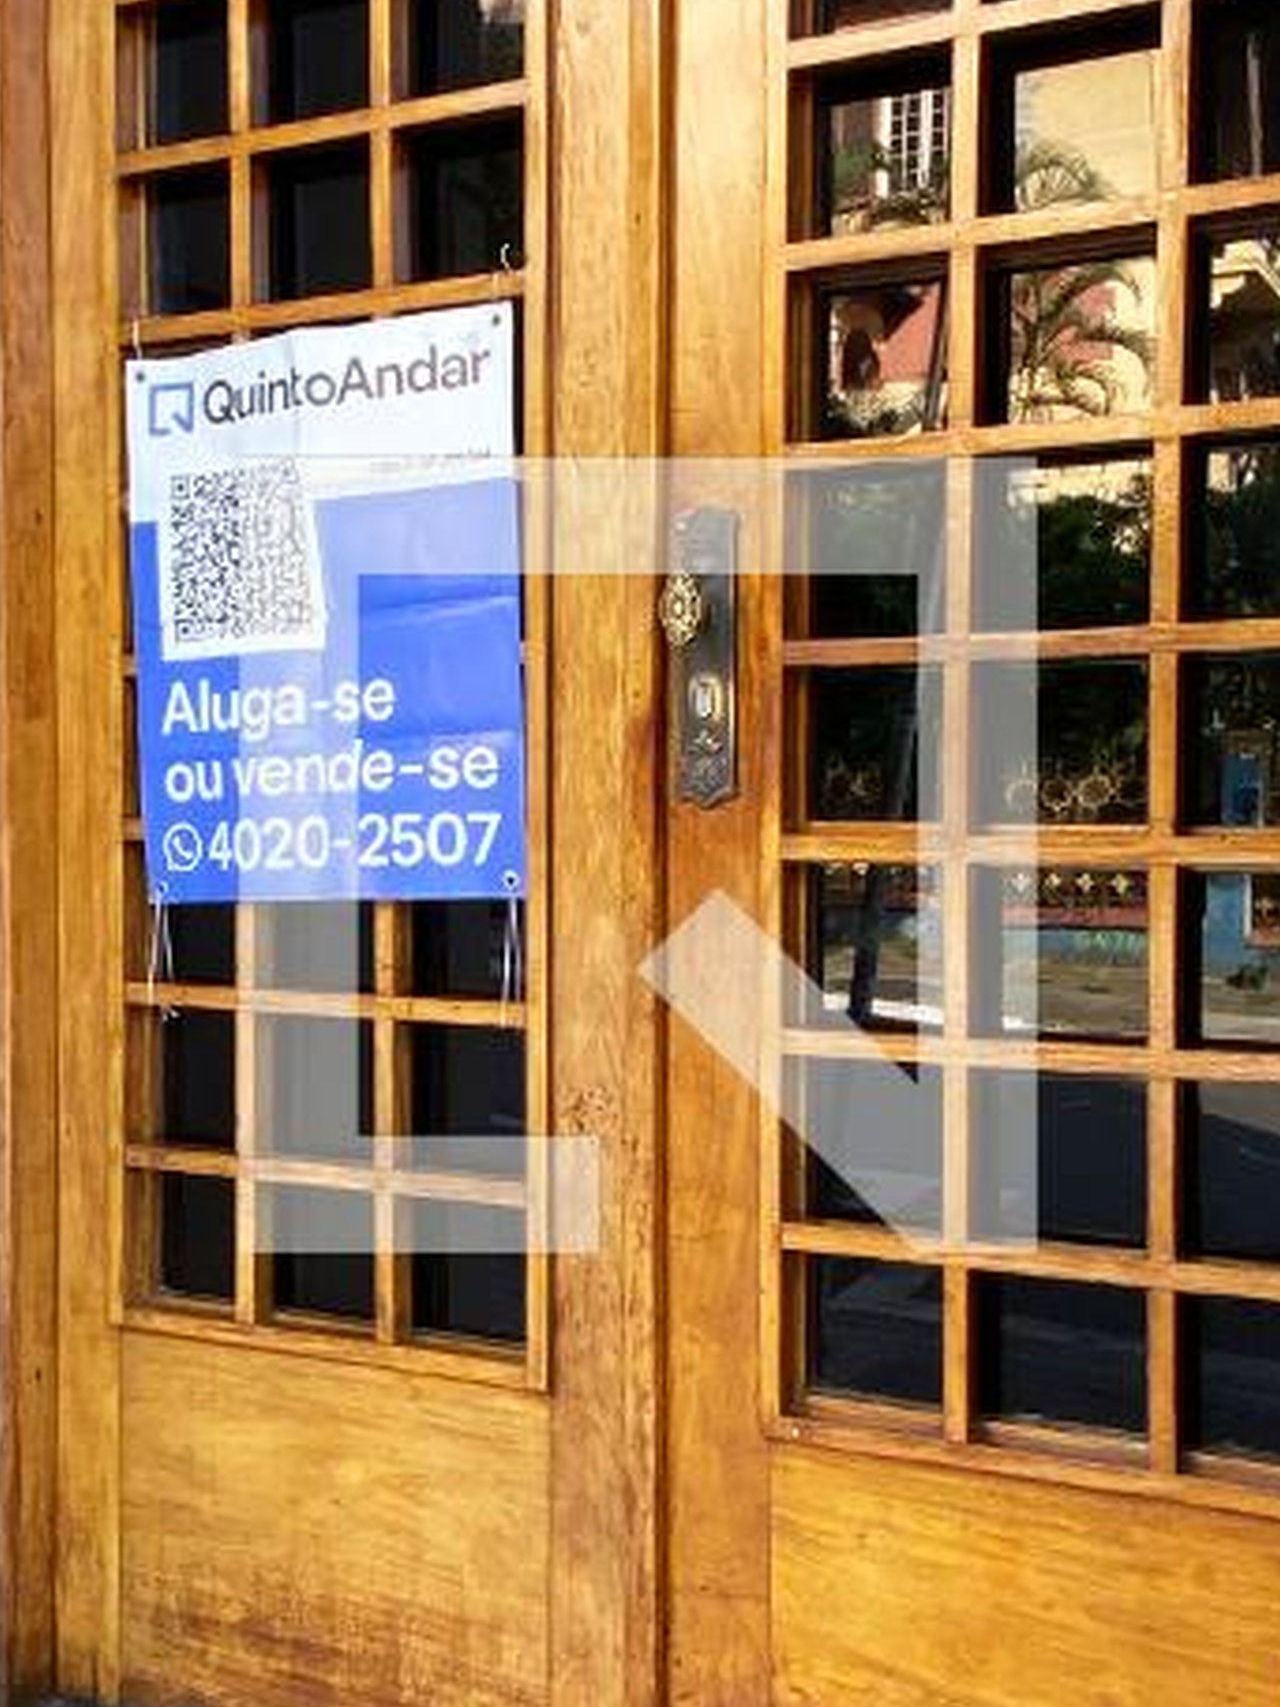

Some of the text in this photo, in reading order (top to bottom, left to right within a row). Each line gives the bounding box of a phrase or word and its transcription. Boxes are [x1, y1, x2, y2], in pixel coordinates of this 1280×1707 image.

[203, 344, 491, 424] QuintoAndar
[161, 679, 396, 742] Aluga-se
[166, 739, 499, 802] ou vende-se
[209, 813, 502, 871] 4020-2507
